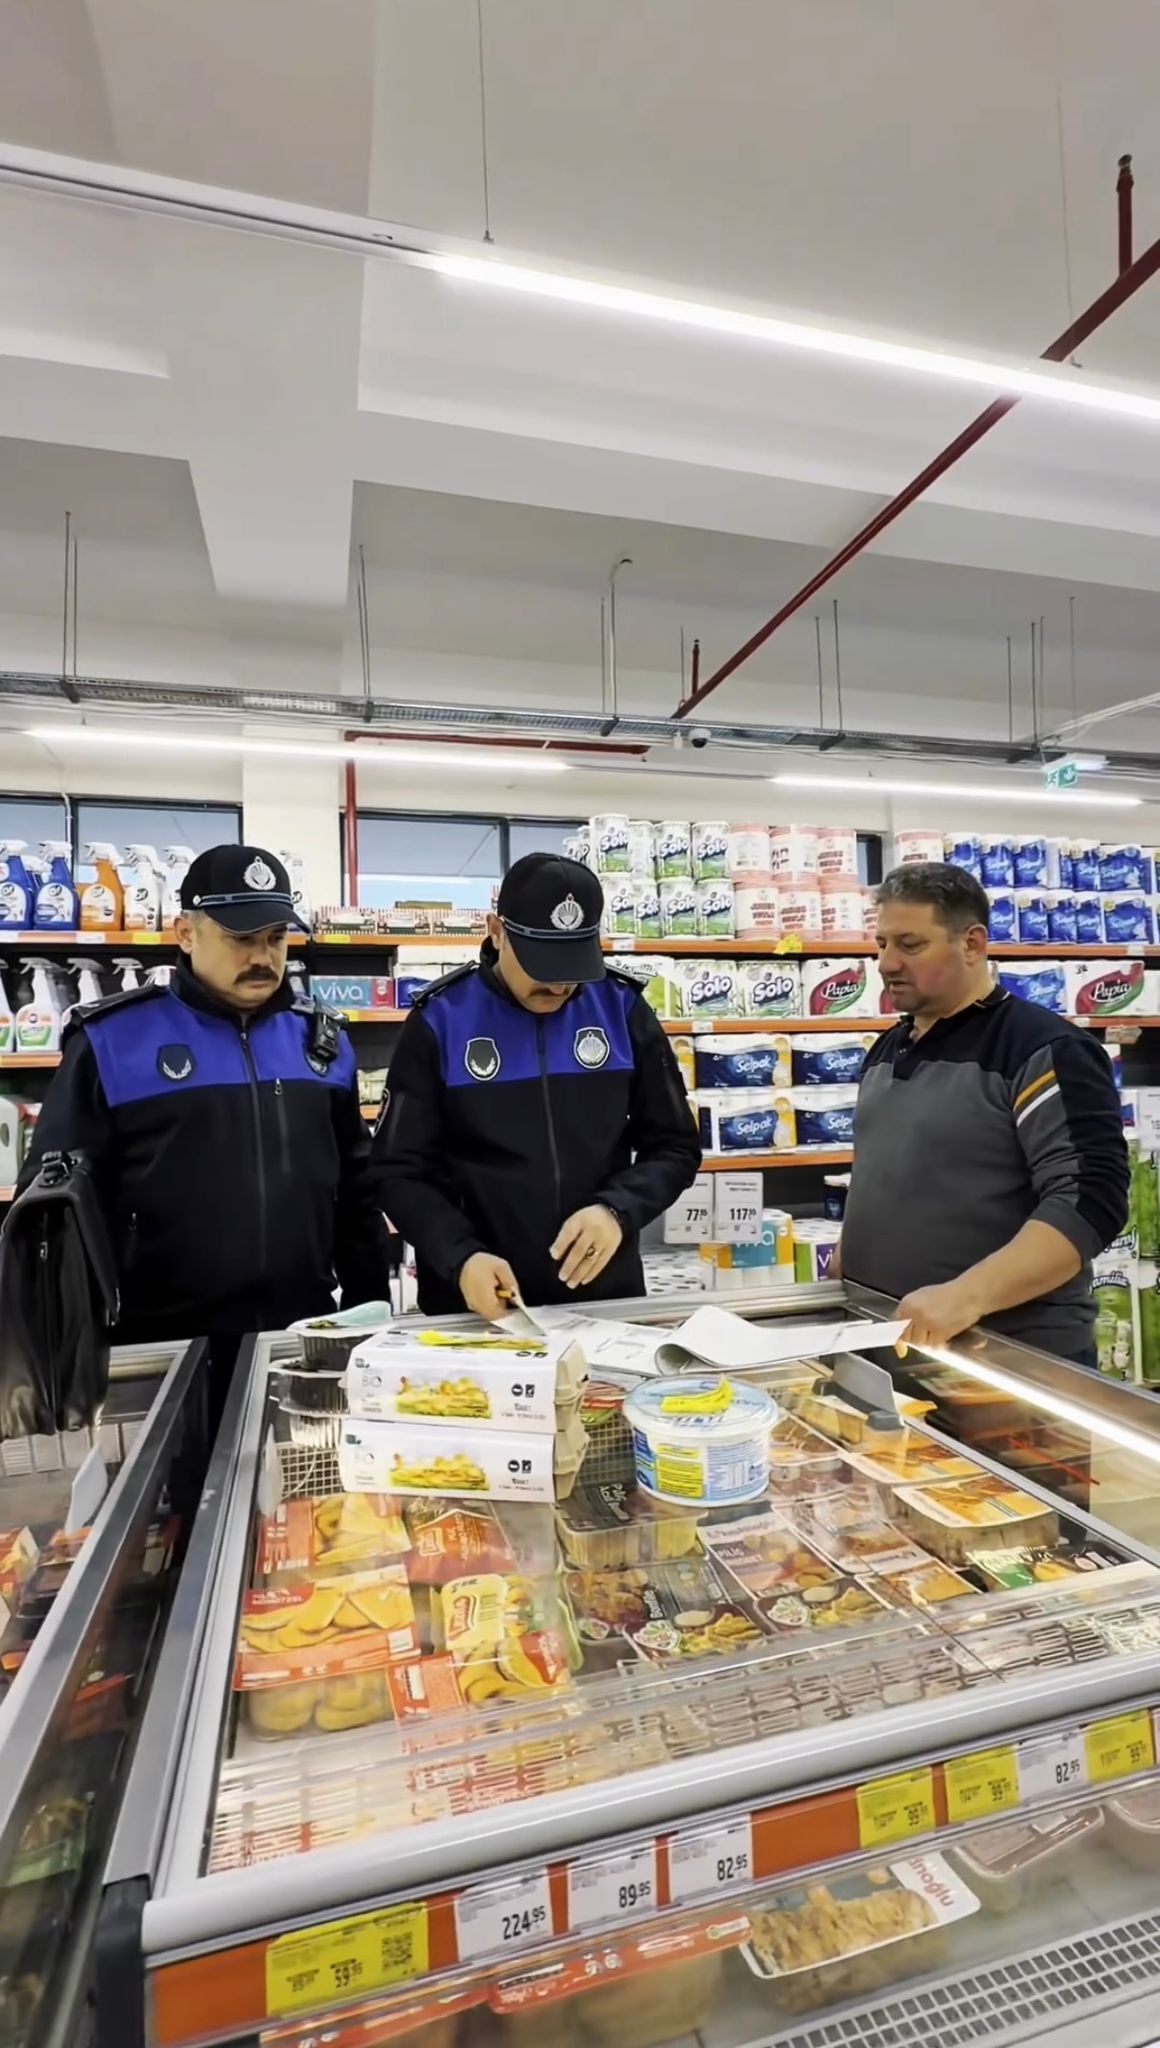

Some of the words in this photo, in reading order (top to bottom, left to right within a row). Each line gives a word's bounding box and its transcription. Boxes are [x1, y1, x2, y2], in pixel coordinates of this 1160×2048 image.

[319, 982, 364, 1000] viva
[690, 976, 733, 1003] Solo
[752, 976, 794, 1003] Solo
[823, 980, 859, 999] Papia
[1091, 979, 1132, 1001] Papia
[736, 1055, 772, 1073] Selpak
[825, 1052, 861, 1071] Selpak
[736, 1115, 773, 1135] Selpak
[827, 1114, 853, 1130] Selp
